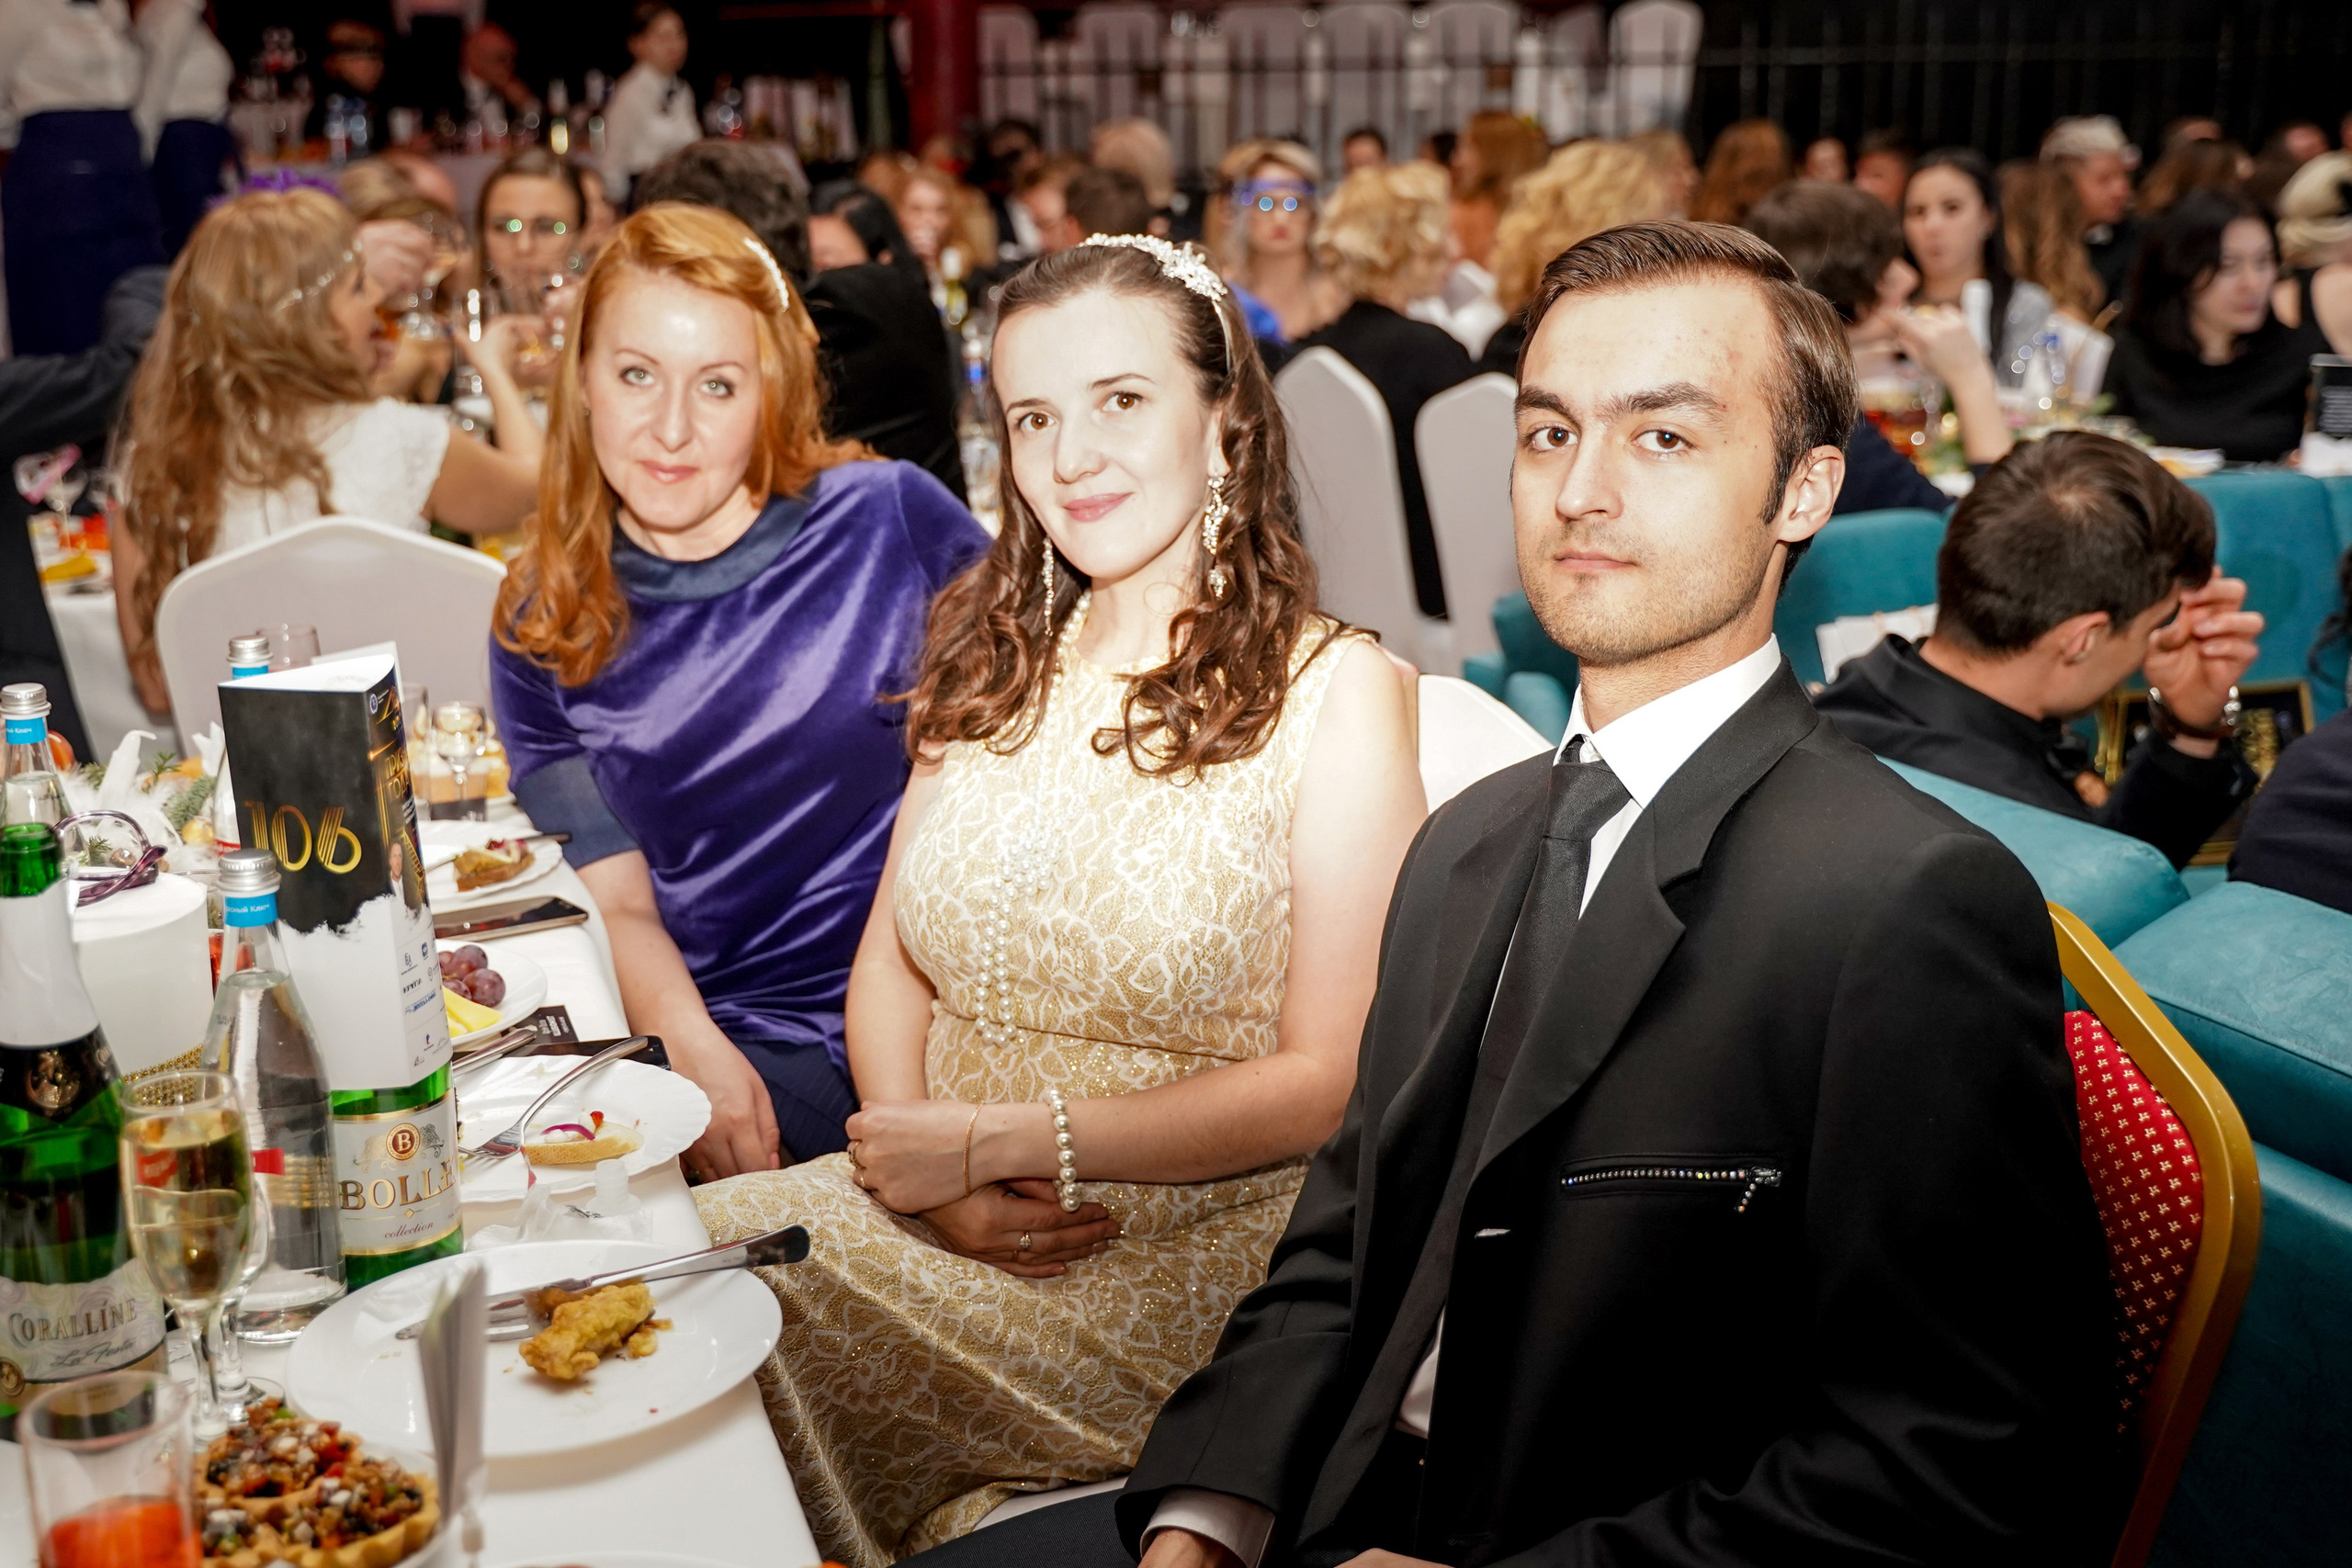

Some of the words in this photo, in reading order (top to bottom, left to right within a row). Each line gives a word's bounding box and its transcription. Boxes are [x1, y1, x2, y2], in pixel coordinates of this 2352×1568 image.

[244, 801, 362, 874] 106
[250, 903, 270, 912] Ключ
[396, 1132, 412, 1152] B
[339, 1156, 457, 1211] BOLLE
[384, 1222, 433, 1239] collection
